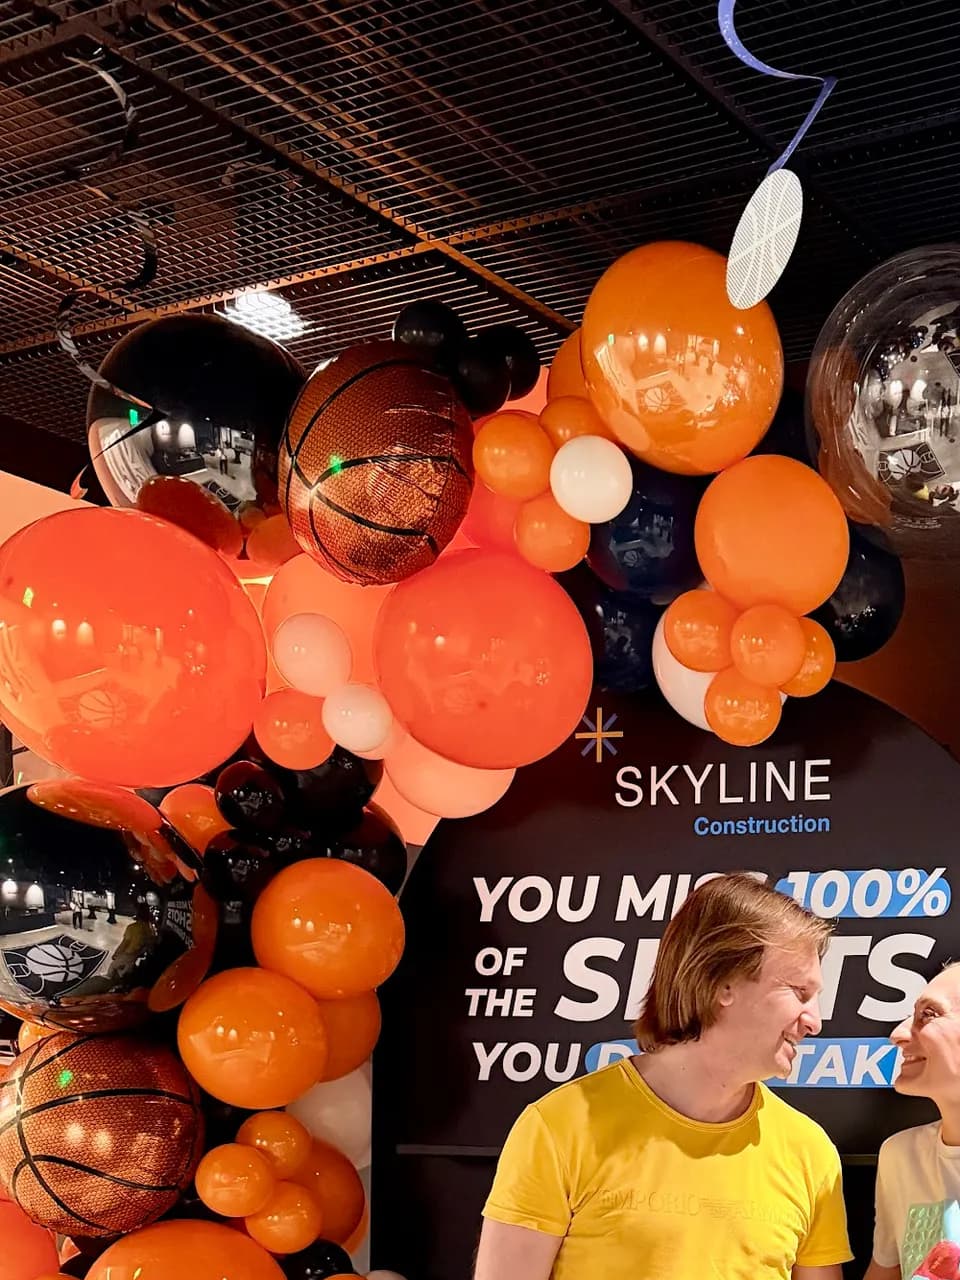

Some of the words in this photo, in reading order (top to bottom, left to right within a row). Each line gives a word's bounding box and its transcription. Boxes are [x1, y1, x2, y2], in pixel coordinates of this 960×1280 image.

[615, 759, 831, 807] SKYLINE
[694, 814, 830, 836] Construction
[473, 875, 600, 923] YOU
[615, 872, 768, 921] MI
[786, 867, 947, 917] 100%
[475, 947, 528, 976] OF
[553, 933, 936, 1023] STS
[465, 988, 537, 1017] THE
[473, 1042, 582, 1083] YOU
